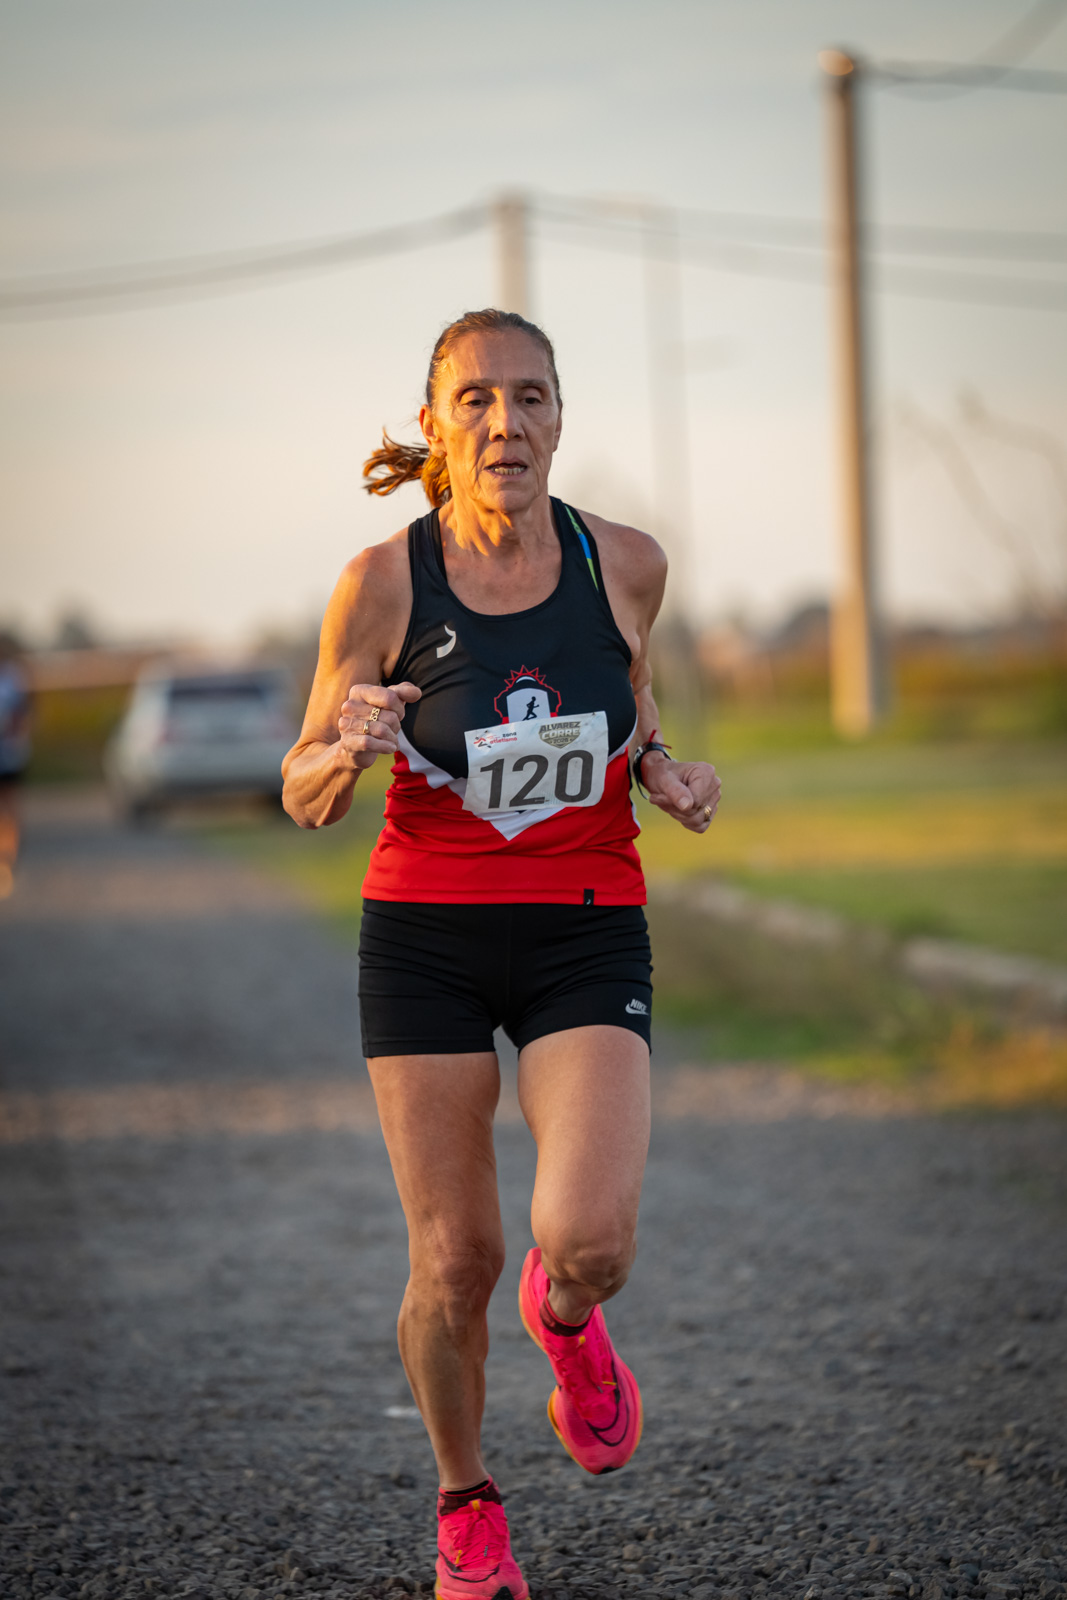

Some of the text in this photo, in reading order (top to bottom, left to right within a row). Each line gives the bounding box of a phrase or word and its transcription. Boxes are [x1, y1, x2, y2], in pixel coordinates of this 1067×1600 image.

[539, 721, 581, 733] ALVAREZ
[541, 729, 580, 740] CORRE
[480, 749, 594, 809] 120
